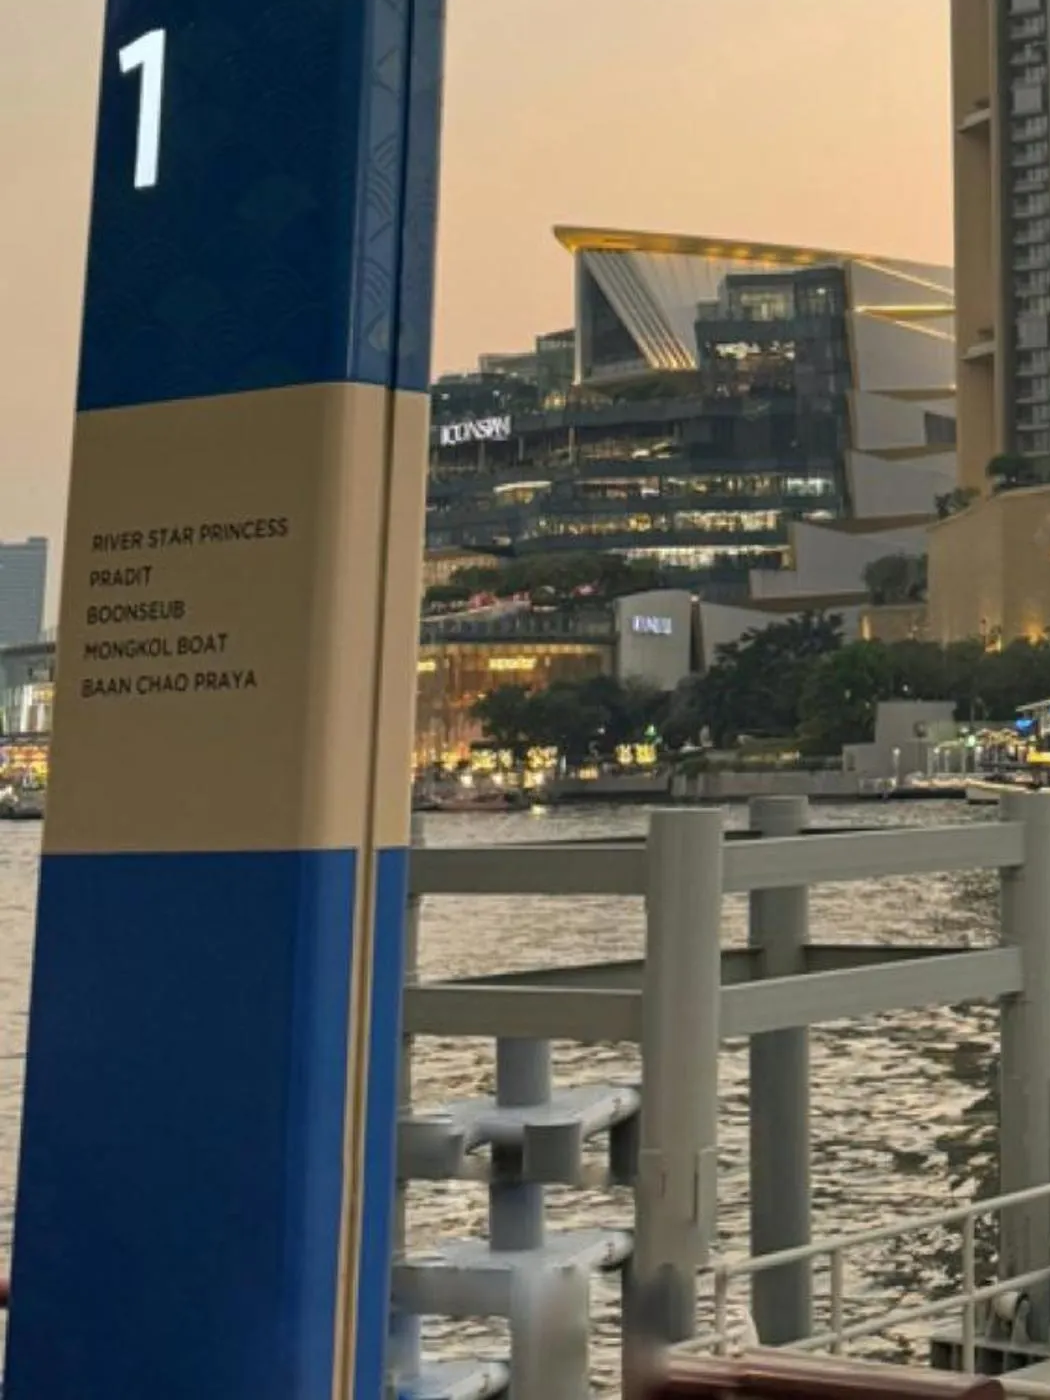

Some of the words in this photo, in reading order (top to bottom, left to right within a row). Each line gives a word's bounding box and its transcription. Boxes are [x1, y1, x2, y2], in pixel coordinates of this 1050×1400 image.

[118, 28, 167, 190] 1
[92, 530, 144, 552] RIVER
[147, 526, 194, 549] STAR
[199, 517, 289, 543] PRINCESS
[89, 565, 153, 588] PRADIT
[86, 600, 186, 625] BOONSEUB
[83, 638, 172, 661] MONGKOL
[176, 633, 228, 656] BOAT
[81, 678, 131, 698] BAAN
[135, 672, 189, 695] CHAO
[194, 669, 257, 691] PRAYA
